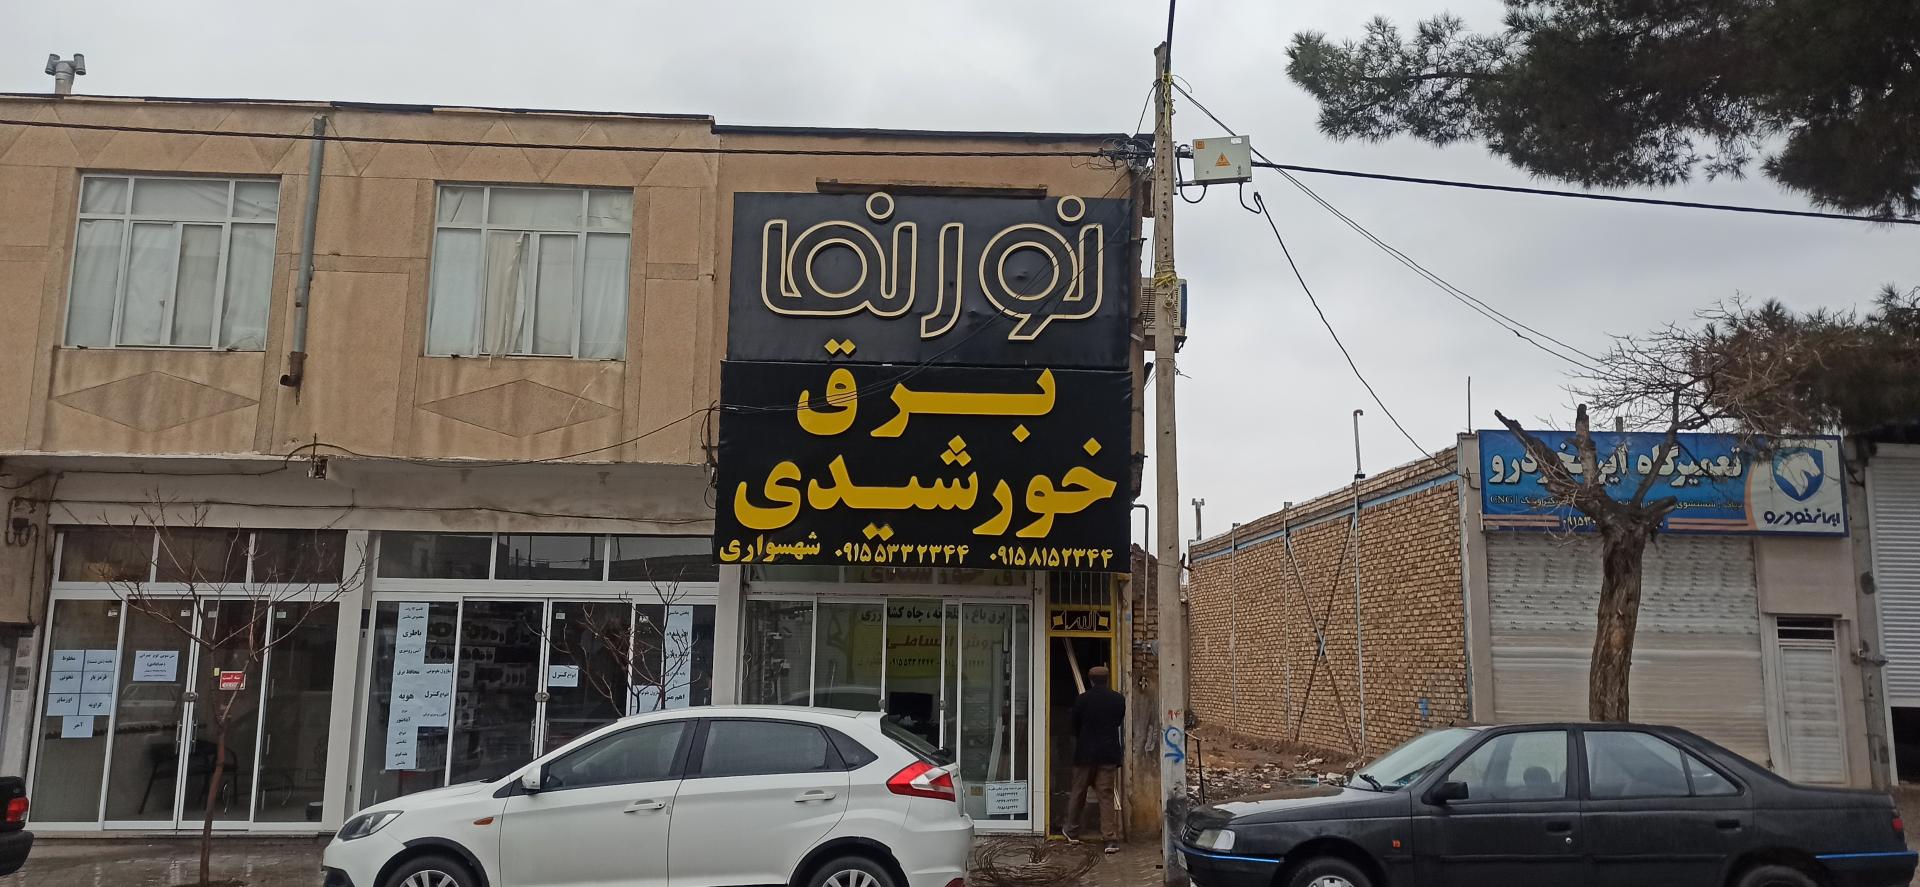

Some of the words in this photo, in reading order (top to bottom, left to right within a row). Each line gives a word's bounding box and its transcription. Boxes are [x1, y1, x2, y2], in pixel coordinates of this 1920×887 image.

[761, 191, 1104, 341] نورنما
[796, 338, 1057, 443] برق
[733, 434, 1118, 542] خورشیدی
[1489, 495, 1514, 506] CNG
[719, 530, 821, 563] شهسواری
[402, 629, 422, 639] باطری
[398, 692, 415, 702] هویه
[424, 690, 440, 699] کنترل
